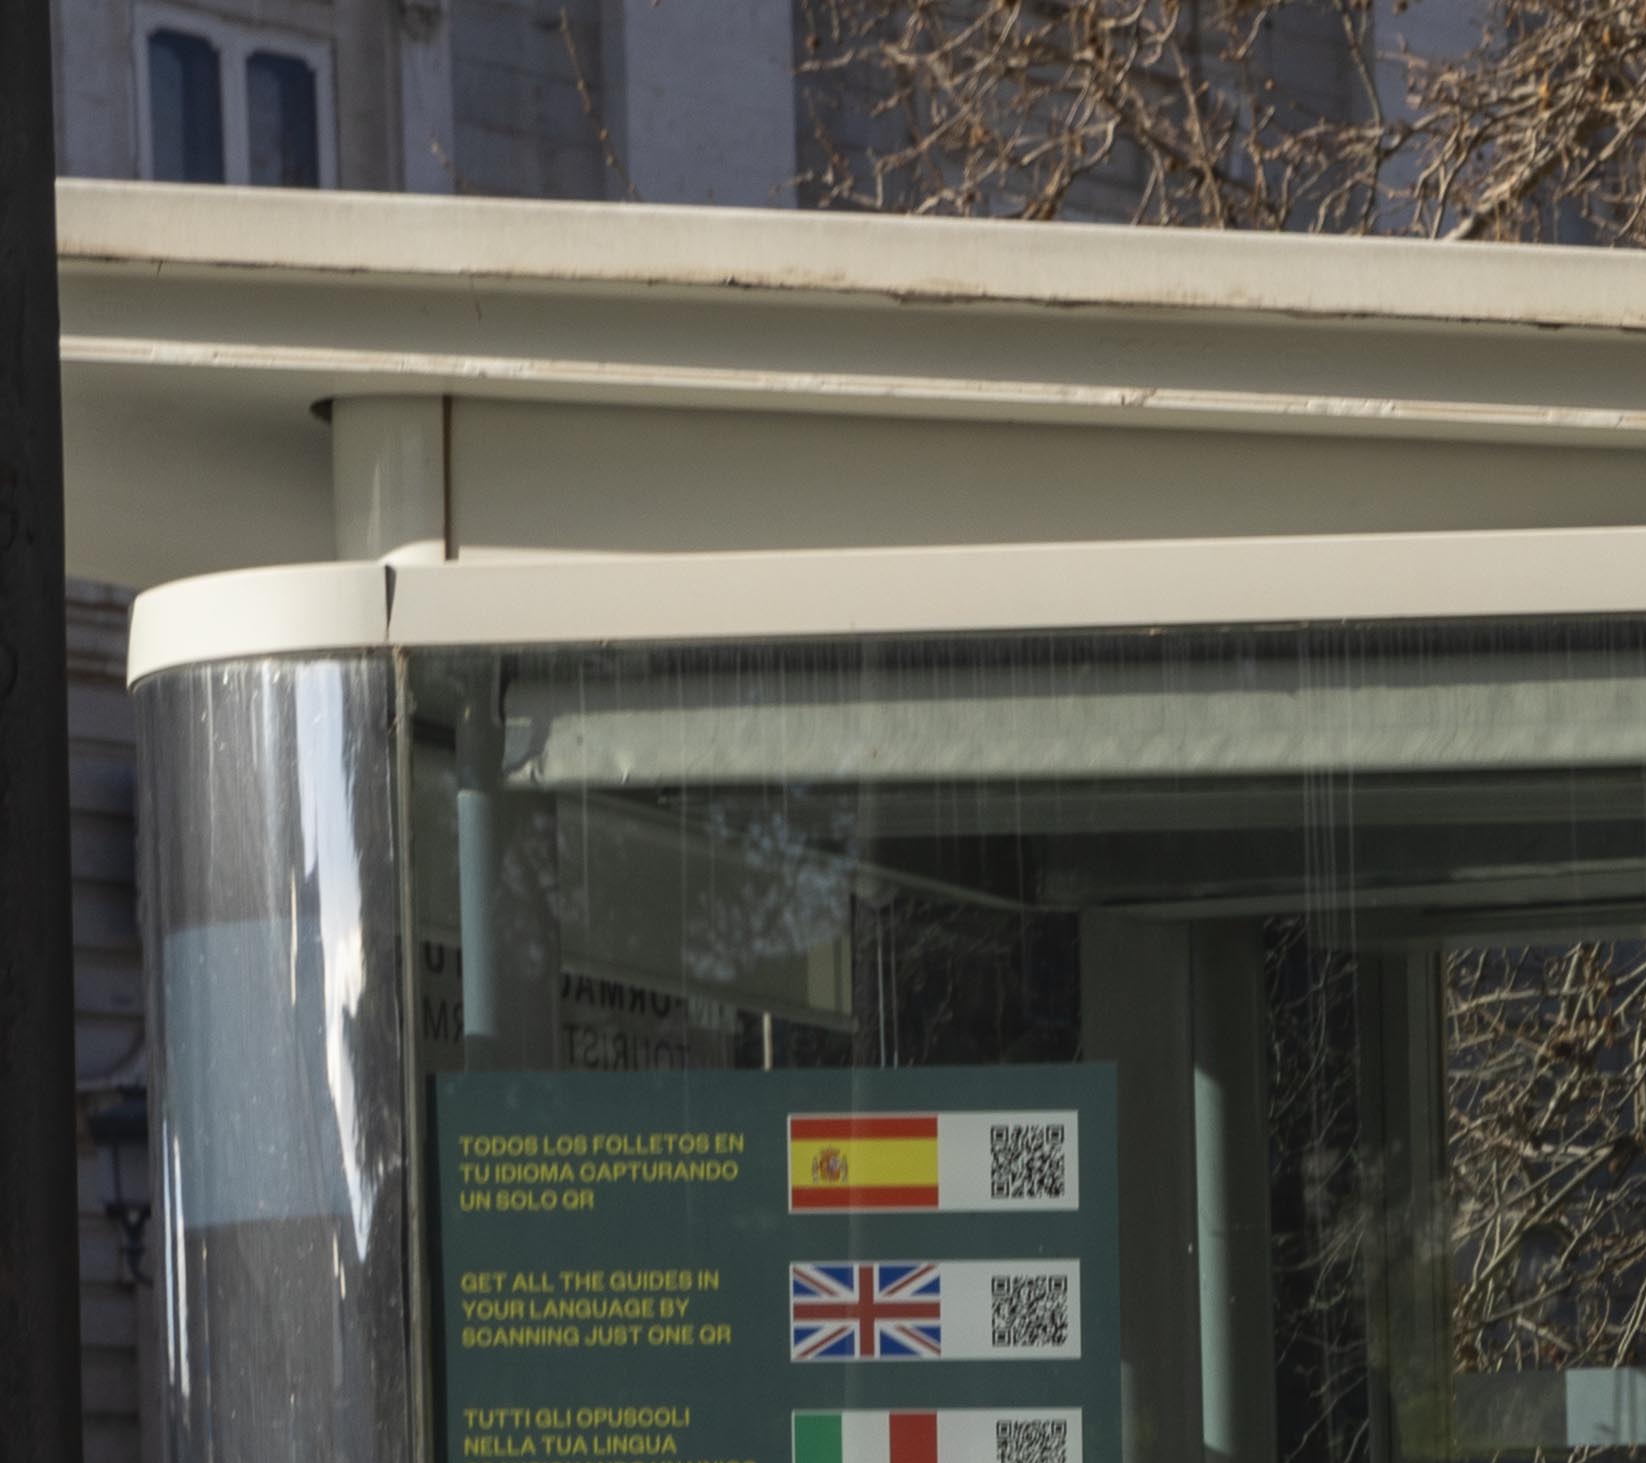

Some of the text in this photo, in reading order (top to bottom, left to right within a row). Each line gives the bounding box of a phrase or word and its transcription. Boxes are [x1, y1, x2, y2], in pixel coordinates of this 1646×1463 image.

[461, 1133, 744, 1157] TODOS LOS FOLLETOS EN
[461, 1160, 739, 1184] TU IDIOMA CAPTURANDO
[459, 1189, 594, 1211] UN SOLO QR
[460, 1270, 720, 1292] GET ALL THE GUIDES IN
[464, 1297, 688, 1319] YOUR LANGUAGE BY
[463, 1324, 732, 1347] SCANNING JUST ONE QR
[465, 1408, 690, 1428] TUTTI GLI OPUSCOLI
[464, 1435, 676, 1456] NELLA TUA LINGUA
